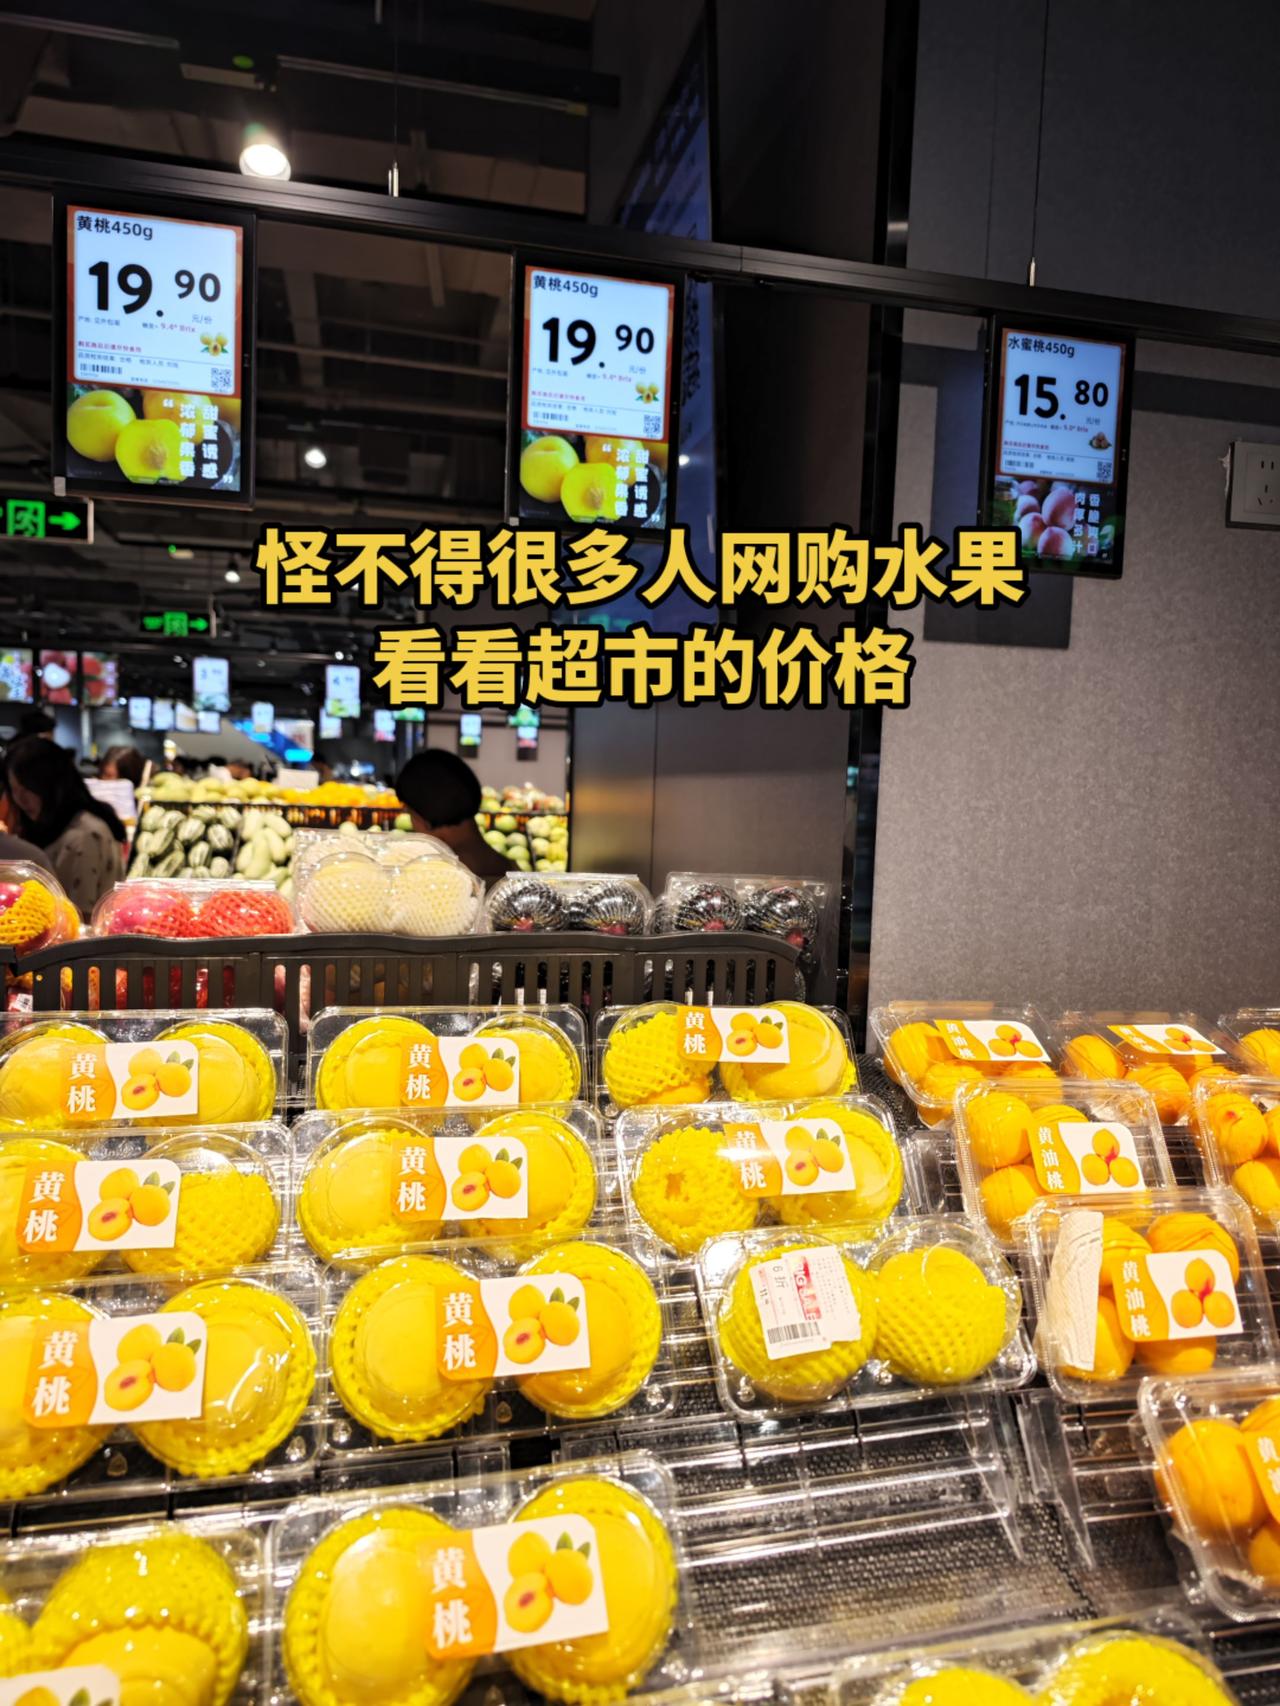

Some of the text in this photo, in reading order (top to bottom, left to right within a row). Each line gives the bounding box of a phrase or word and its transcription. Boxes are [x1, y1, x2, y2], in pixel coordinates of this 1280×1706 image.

[77, 215, 153, 241] 黄桃450g
[174, 269, 221, 303] 90
[533, 275, 599, 298] 黄桃450g
[615, 324, 654, 354] 90
[1008, 336, 1075, 358] 水蜜桃450g
[1074, 379, 1109, 407] 80
[683, 1011, 707, 1054] 黄桃
[67, 1053, 98, 1114] 黄桃
[405, 1044, 432, 1101] 黄桃
[396, 1146, 427, 1213] 黄桃
[735, 1130, 767, 1190] 黄桃
[1038, 1126, 1064, 1190] 黄油桃
[23, 1171, 66, 1244] 黄桃
[1122, 1260, 1151, 1337] 黄油桃
[442, 1291, 477, 1371] 黄桃
[32, 1330, 79, 1418] 黄桃
[432, 1546, 473, 1650] 黄桃
